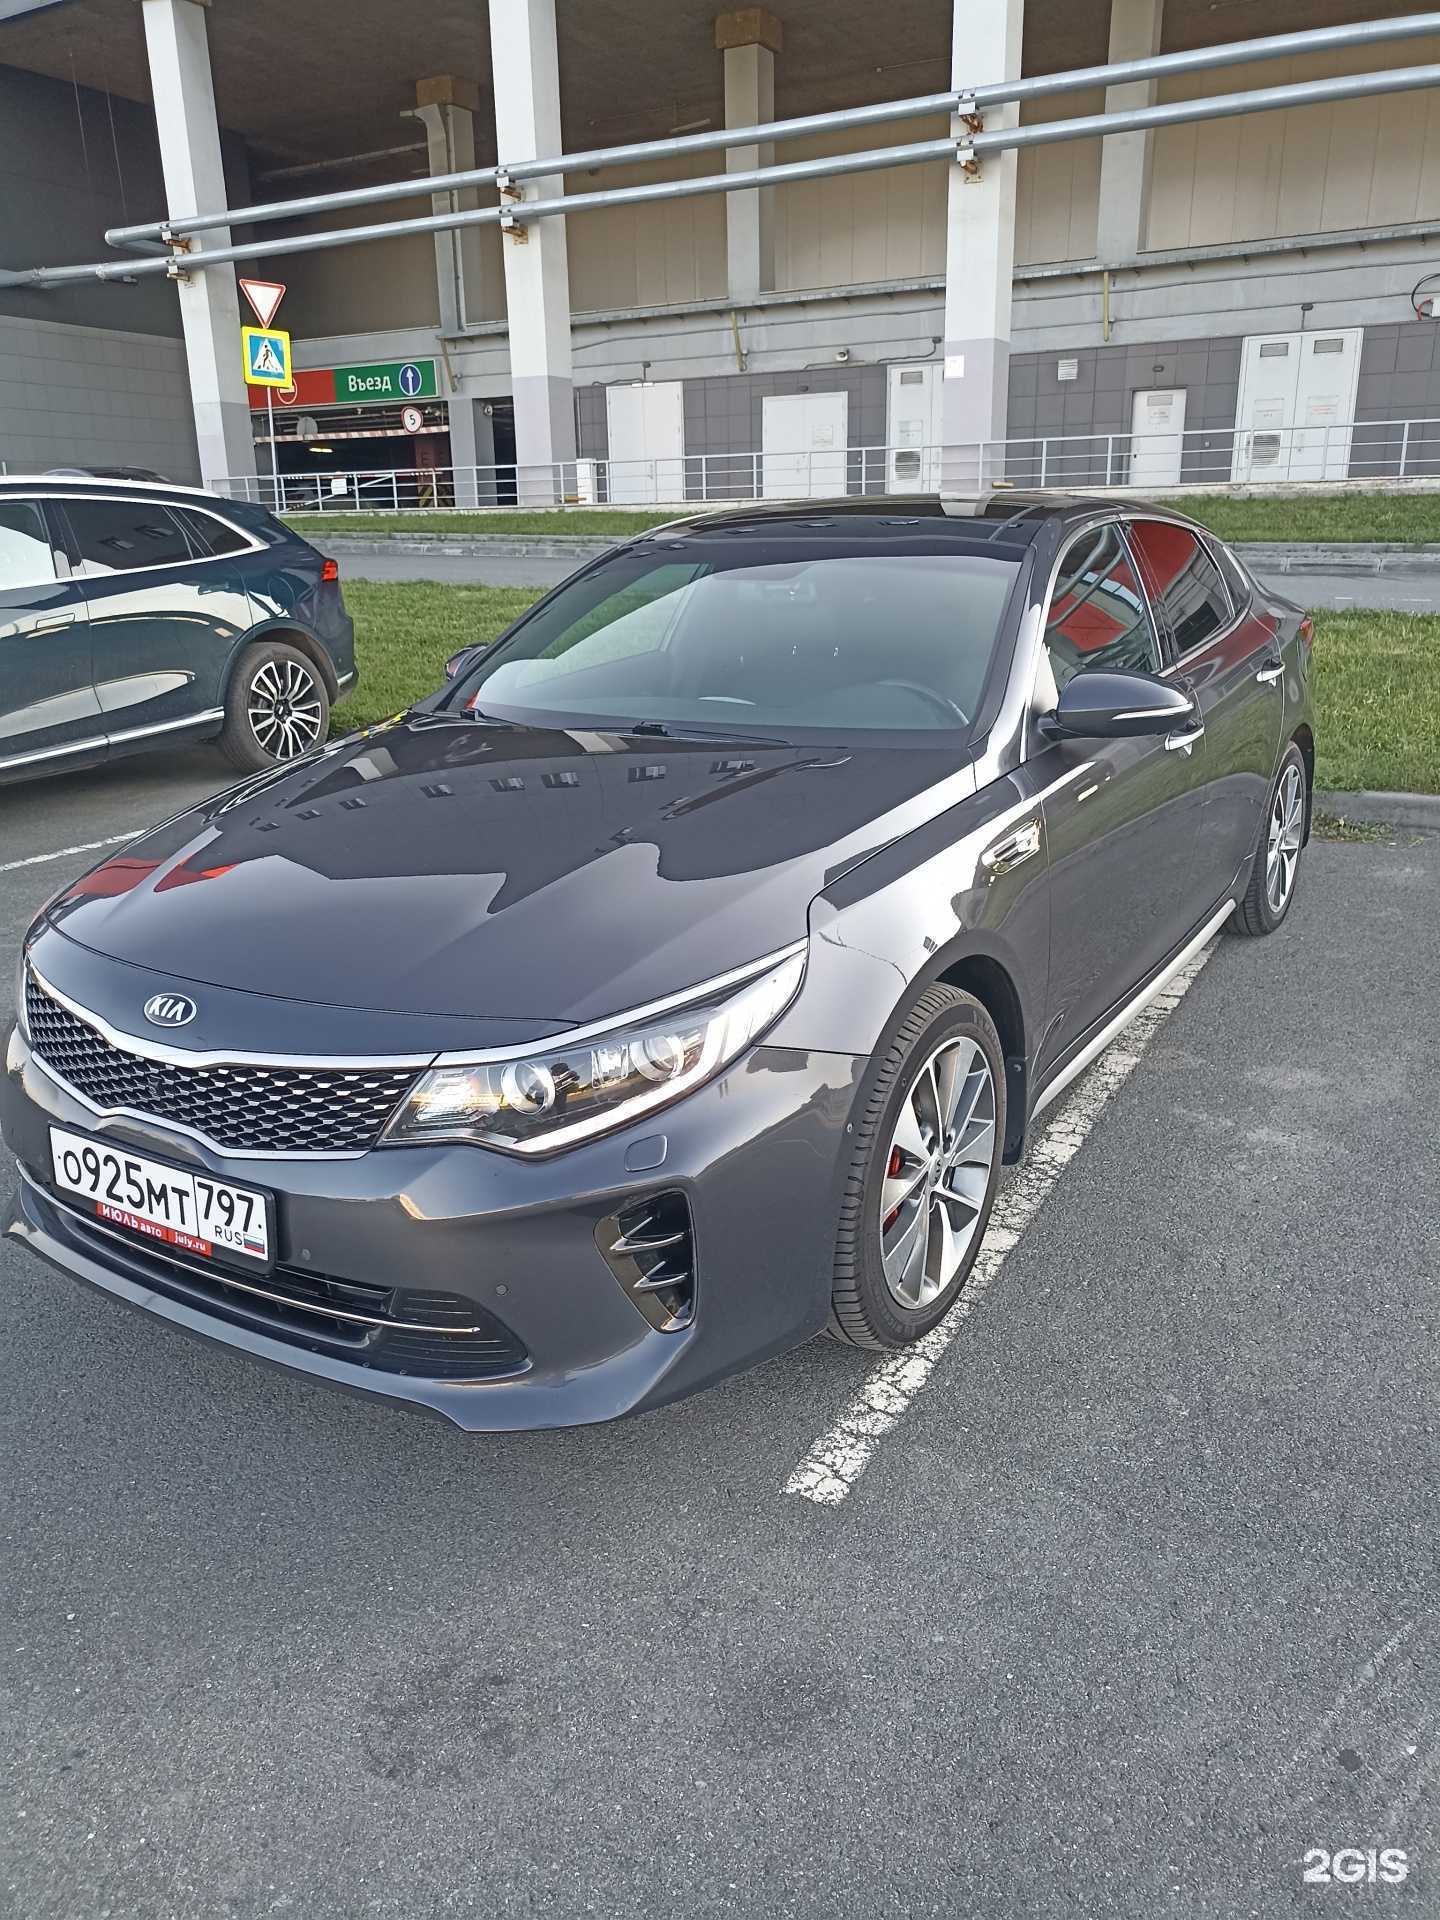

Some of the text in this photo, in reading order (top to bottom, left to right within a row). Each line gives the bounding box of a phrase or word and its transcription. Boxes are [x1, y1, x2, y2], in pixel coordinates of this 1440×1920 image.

[348, 374, 392, 392] Въезд
[409, 414, 416, 425] 5
[148, 996, 186, 1021] KIA
[197, 1181, 254, 1233] 797
[102, 1204, 162, 1238] ИЮЛЬ авто
[174, 1231, 207, 1252] july.ru
[214, 1225, 243, 1246] RUS
